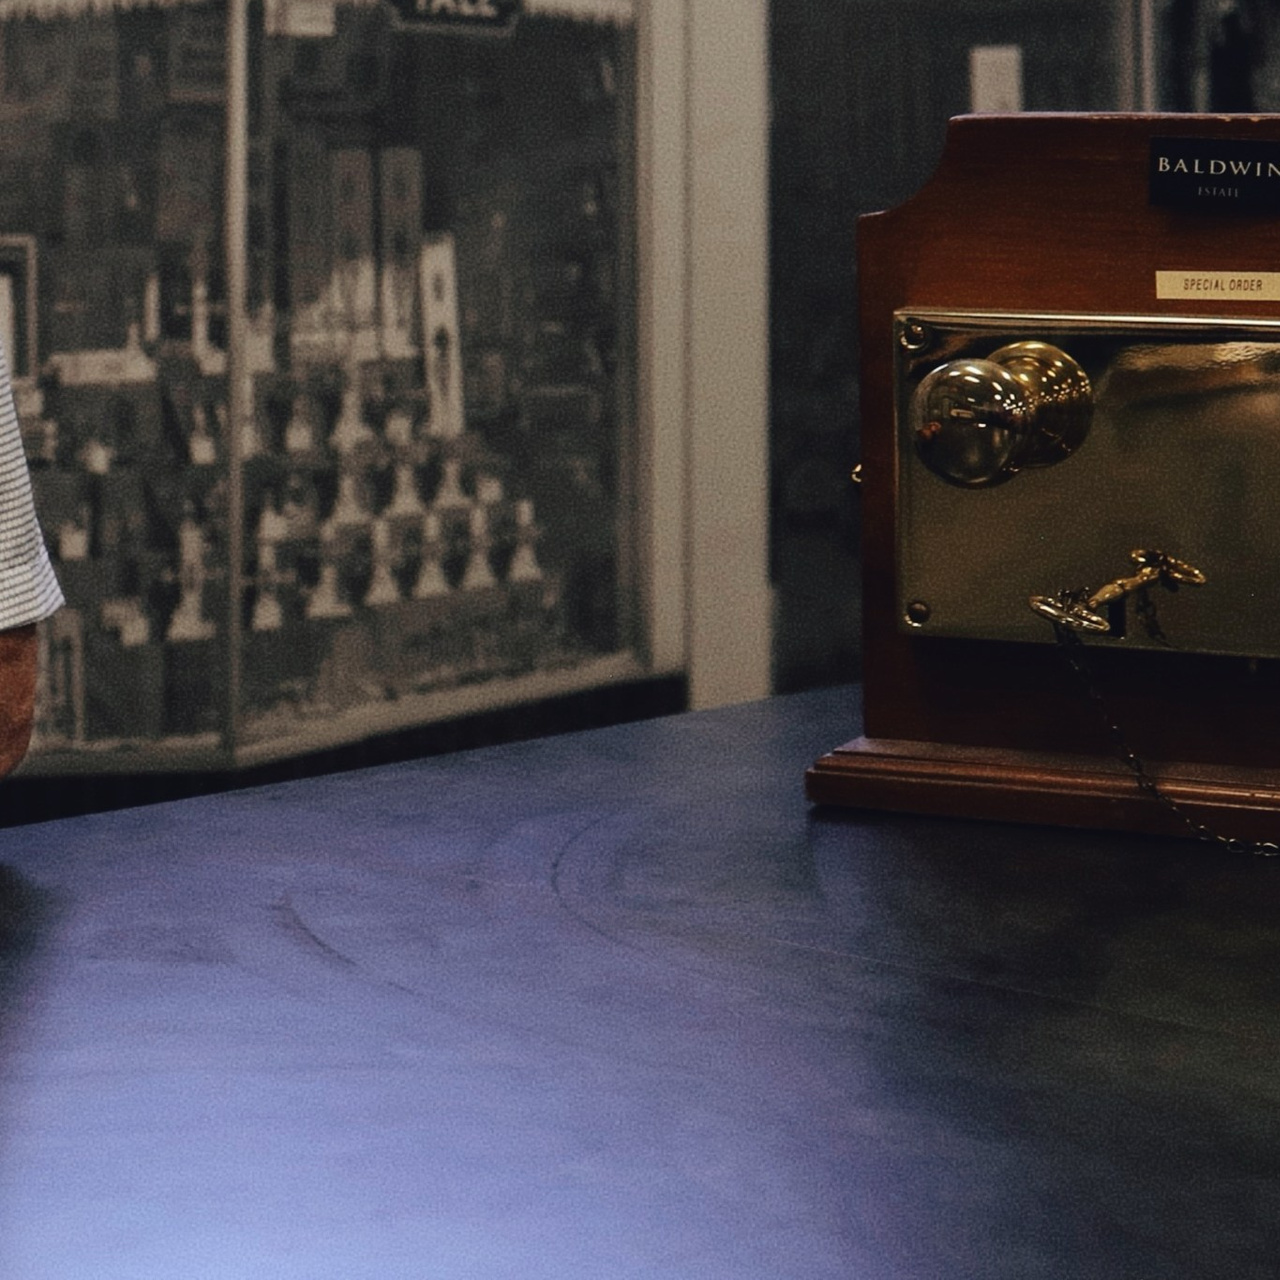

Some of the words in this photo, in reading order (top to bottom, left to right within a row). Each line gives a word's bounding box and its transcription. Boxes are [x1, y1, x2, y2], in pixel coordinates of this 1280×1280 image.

[1158, 156, 1280, 177] BALDWIN
[1197, 186, 1239, 198] ESTATE
[1183, 278, 1225, 291] SPECIAL
[1229, 278, 1262, 292] ORDER
